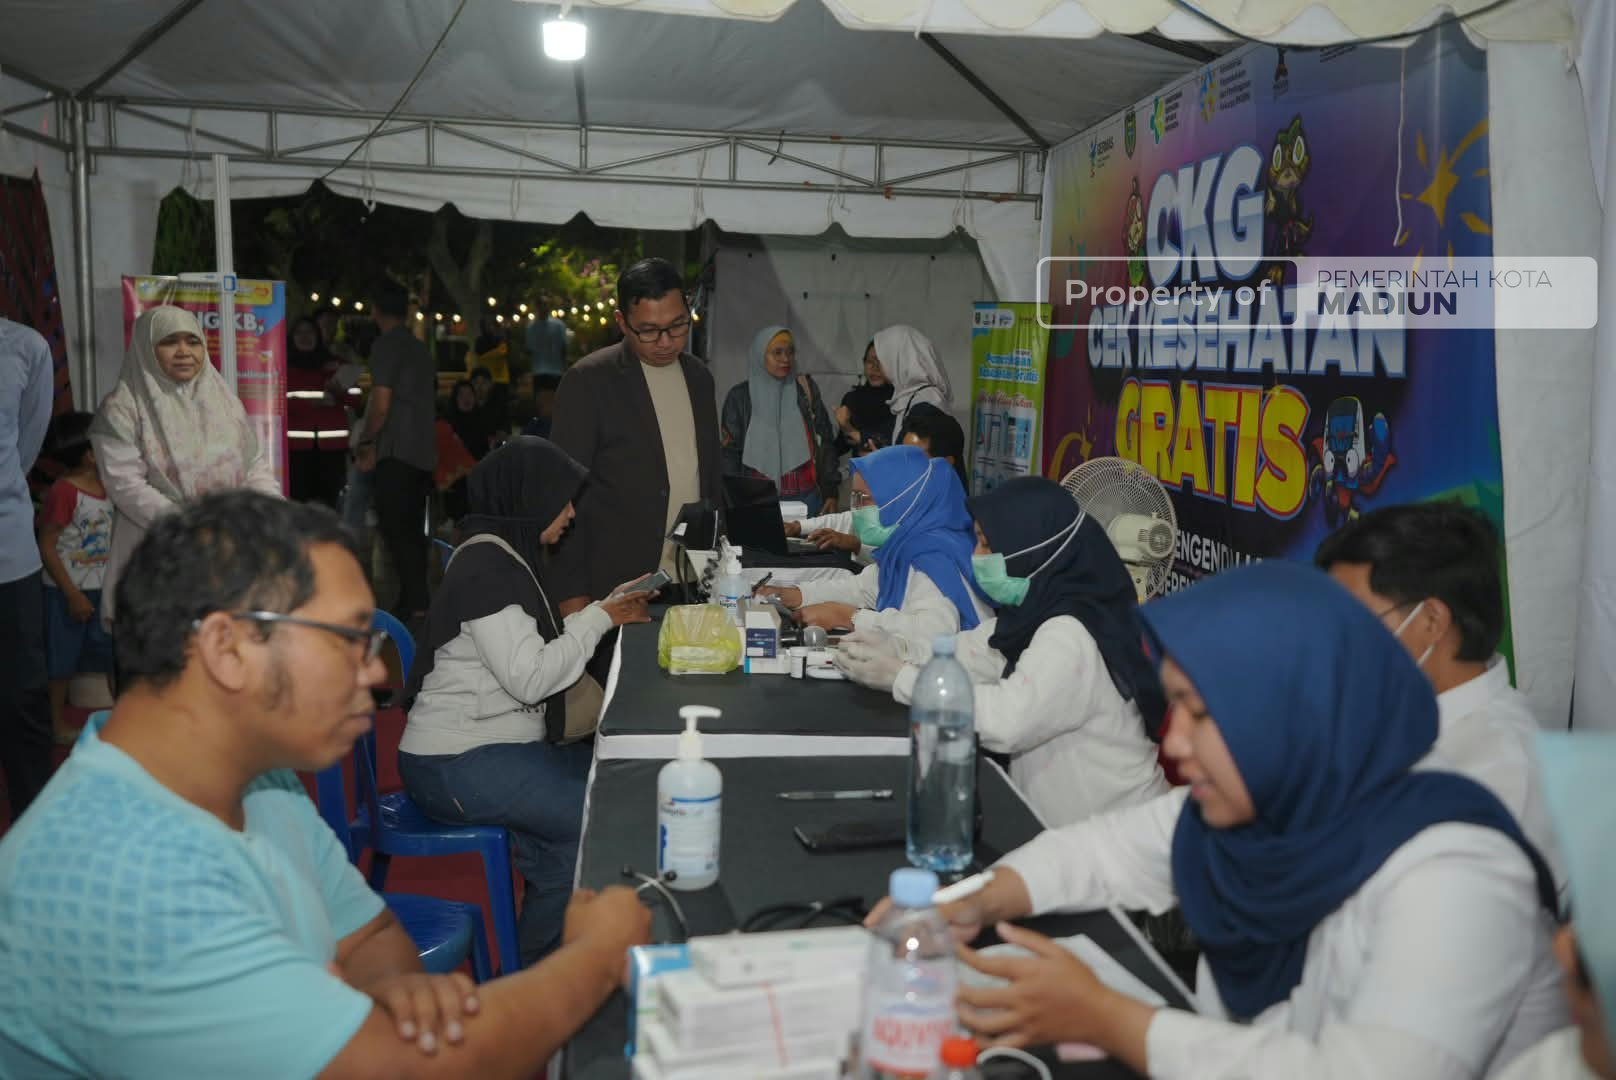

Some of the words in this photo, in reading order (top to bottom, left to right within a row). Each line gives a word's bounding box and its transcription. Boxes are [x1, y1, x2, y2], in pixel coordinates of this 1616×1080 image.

[1146, 145, 1264, 286] CKG
[1088, 302, 1136, 369] CEK
[1137, 281, 1407, 378] KESEHATAN
[1114, 376, 1311, 520] GRATIS
